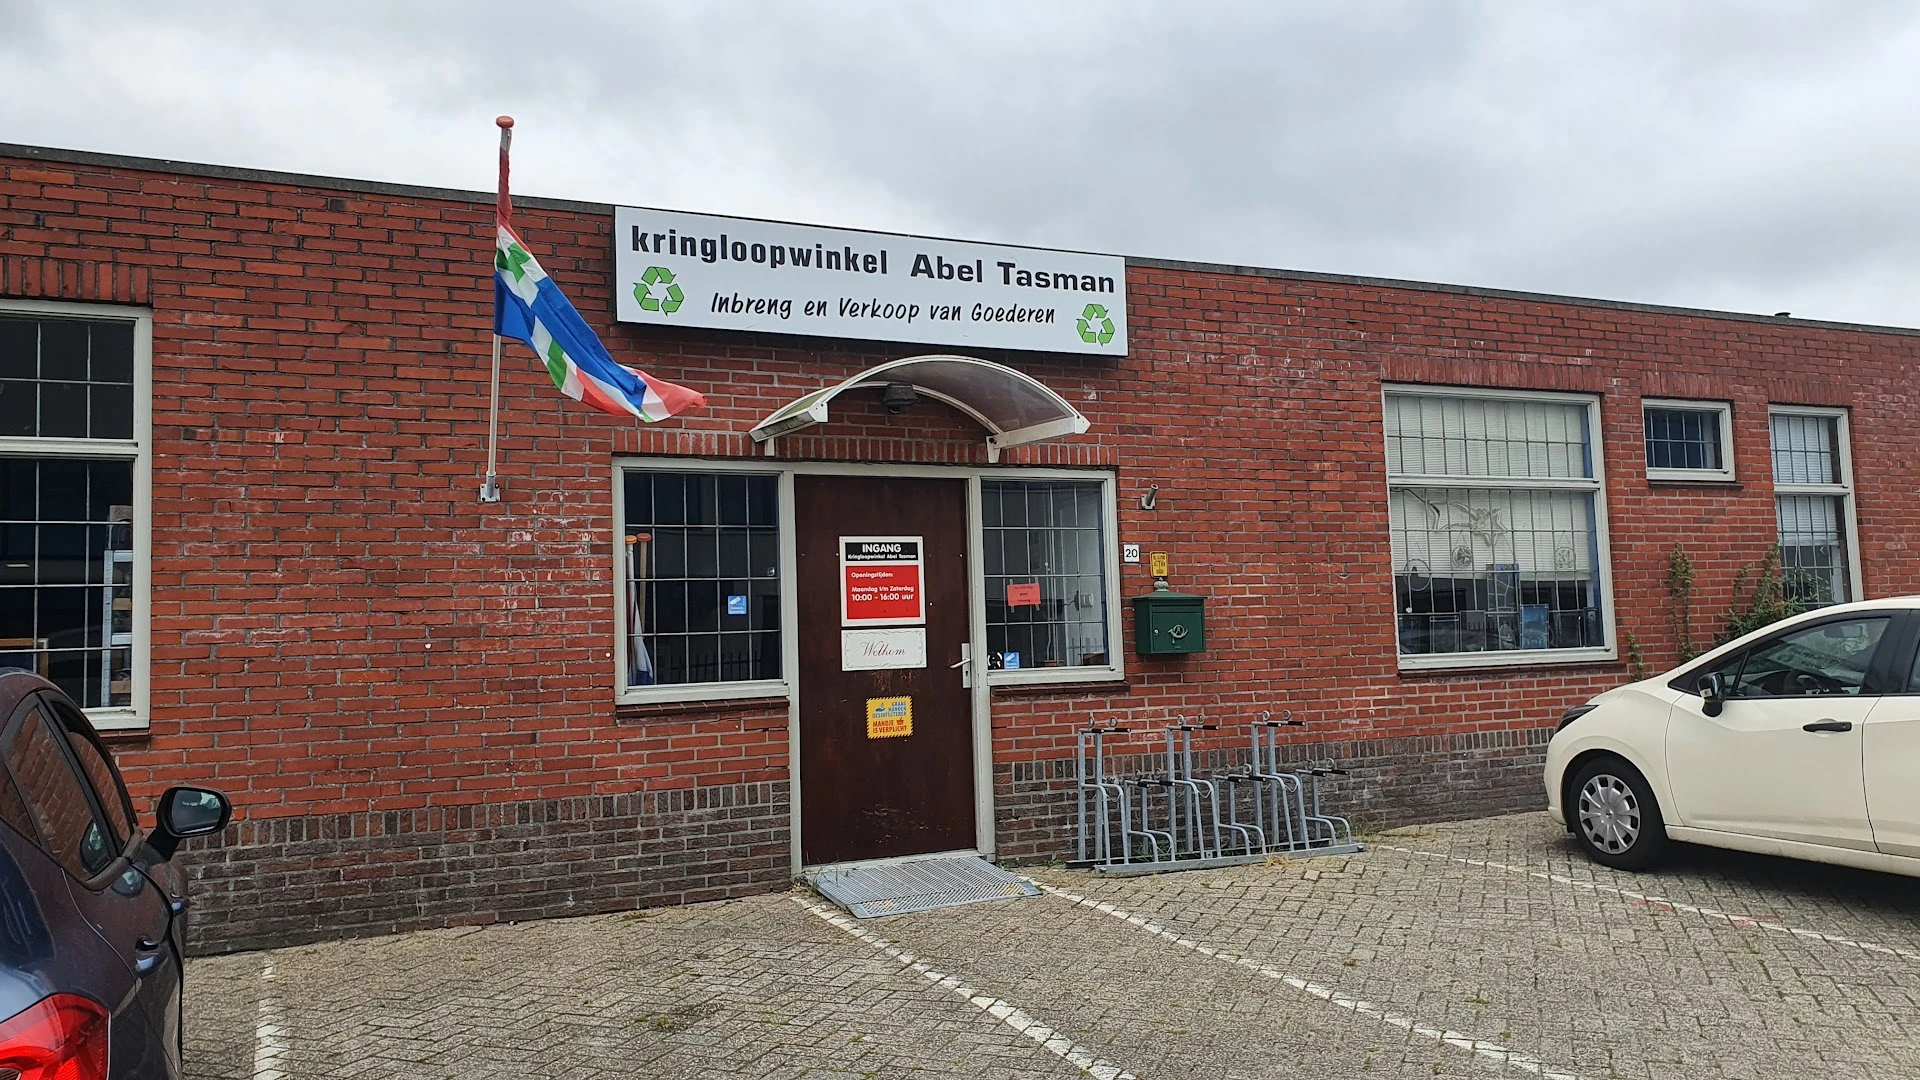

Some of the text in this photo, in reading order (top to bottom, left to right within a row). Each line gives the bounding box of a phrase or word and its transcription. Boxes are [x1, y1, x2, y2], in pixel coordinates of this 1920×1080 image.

[631, 225, 1115, 293] kringloopwinkel Abel Tasman
[710, 292, 1055, 325] Inbreng en Verkoop van Goederen
[862, 543, 902, 553] INGANG
[1125, 548, 1138, 558] 20
[880, 593, 900, 601] 16:00
[860, 640, 907, 657] Welkom
[878, 725, 907, 733] VERPLICHT
